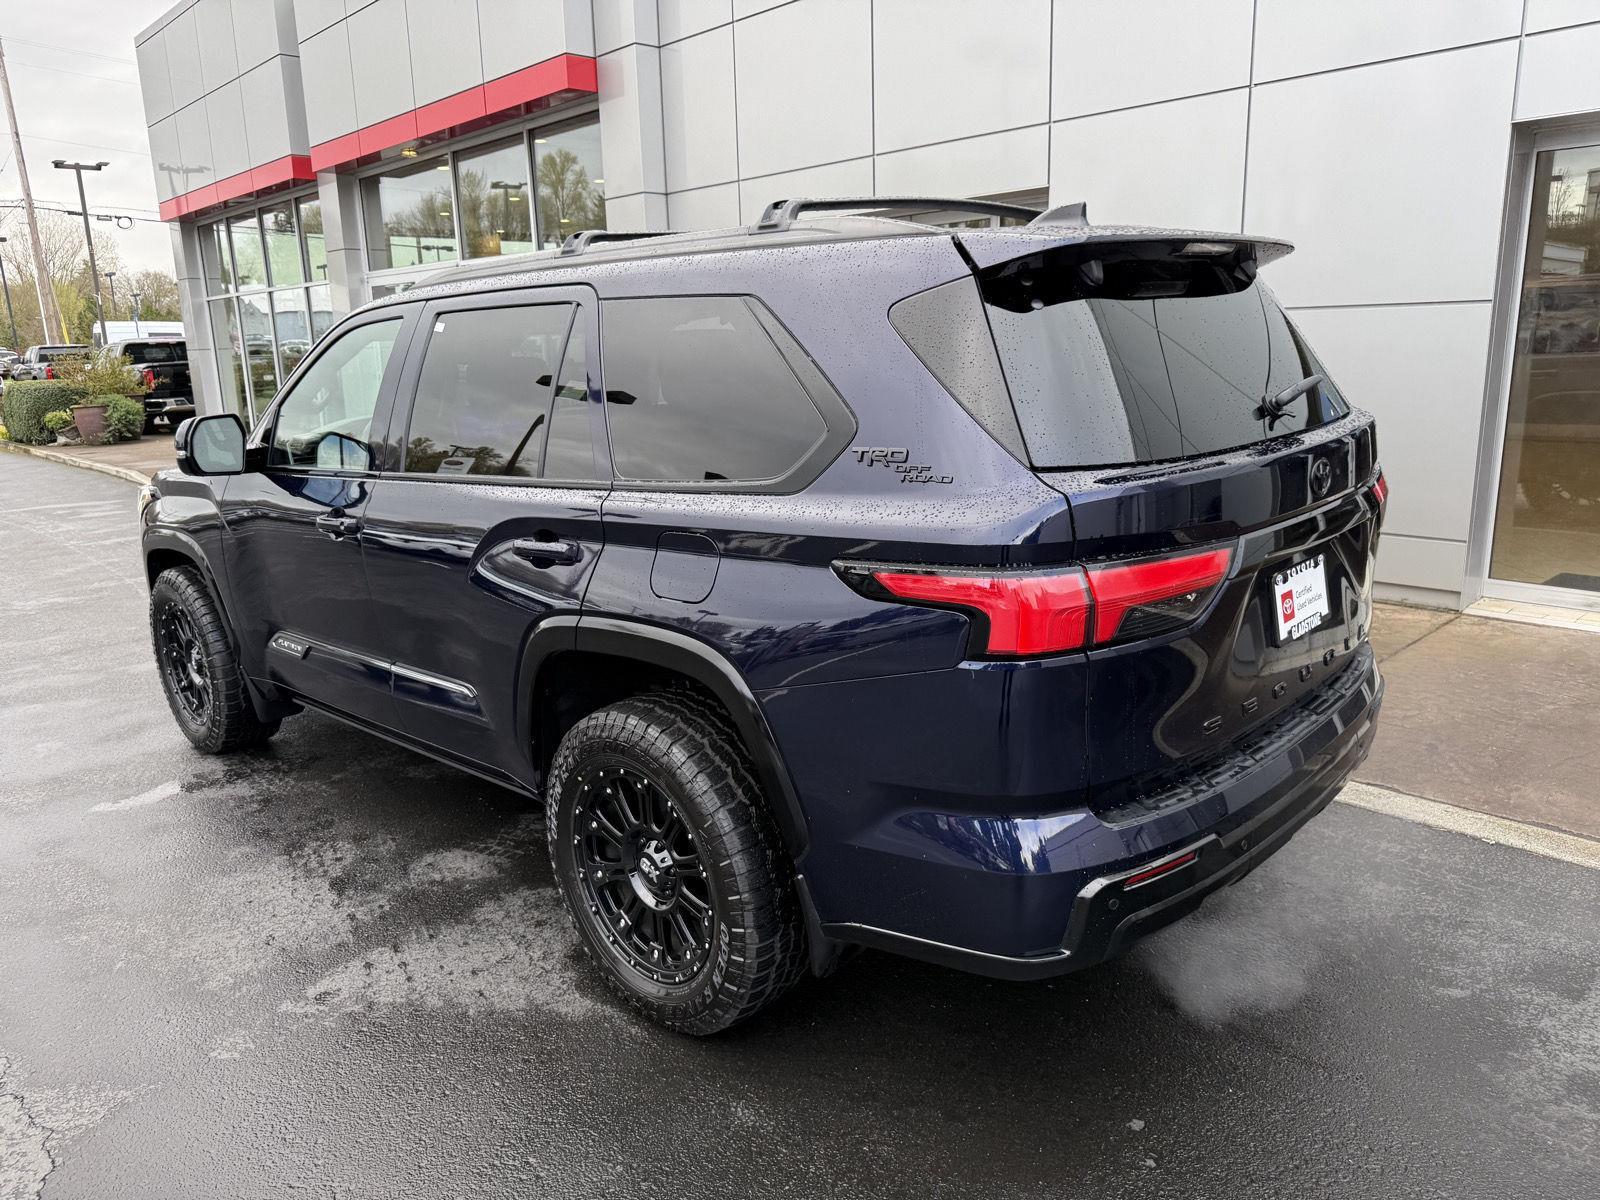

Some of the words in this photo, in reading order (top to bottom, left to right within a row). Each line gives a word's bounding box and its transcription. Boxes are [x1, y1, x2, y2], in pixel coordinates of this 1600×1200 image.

[852, 446, 909, 468] TRD
[895, 464, 932, 475] OFF
[901, 474, 954, 484] ROAD
[1286, 558, 1316, 578] TOYOTA
[1295, 584, 1313, 599] Certified
[1296, 601, 1308, 611] Used
[1306, 592, 1323, 607] Vehicles
[712, 921, 730, 990] OPEN
